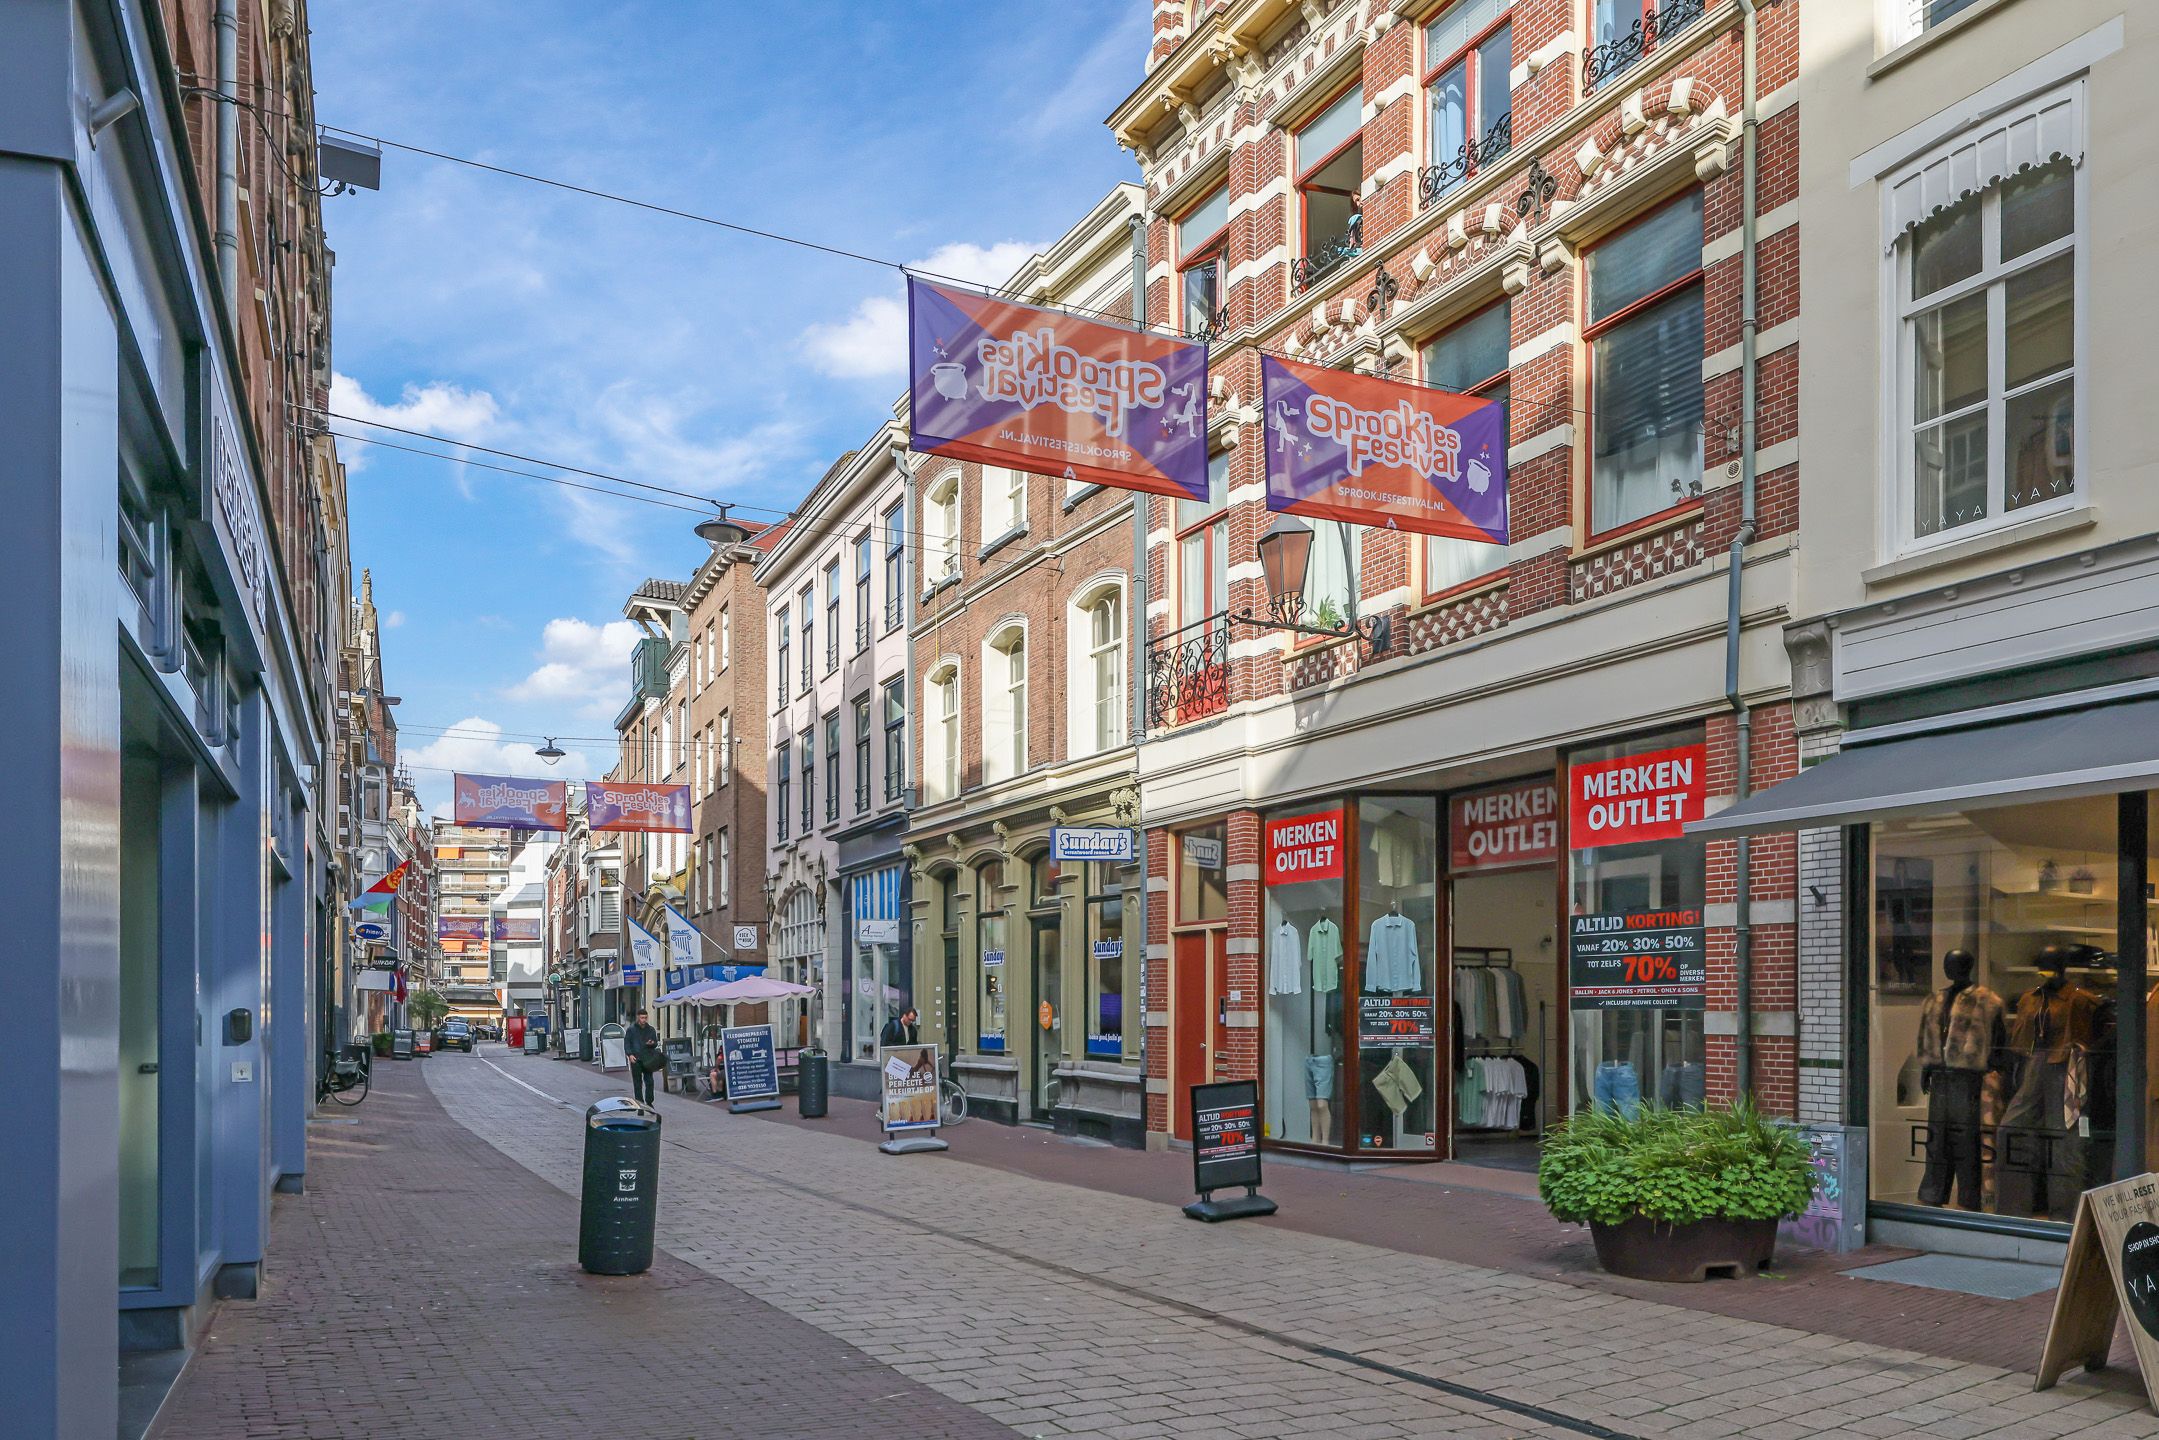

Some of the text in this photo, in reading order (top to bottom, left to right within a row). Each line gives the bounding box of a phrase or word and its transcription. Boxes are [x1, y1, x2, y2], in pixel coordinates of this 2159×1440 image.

[1309, 400, 1459, 453] Sprookjes
[1351, 433, 1457, 478] Festival
[1338, 486, 1446, 512] SPROOKJESFESTIVAL.NL
[1583, 758, 1693, 800] MERKEN
[604, 789, 669, 805] Sprookjes
[1464, 786, 1557, 826] MERKEN
[623, 801, 669, 815] Festival
[1588, 793, 1688, 831] OUTLET
[1273, 819, 1337, 849] MERKEN
[1468, 820, 1557, 857] OUTLET
[1060, 832, 1128, 855] Sunday's
[1275, 845, 1335, 873] OUTLET
[1576, 909, 1700, 933] ALTIJD KORTING!
[1577, 935, 1694, 953] VANAF 20% 30% 50%
[1587, 954, 1677, 983] TOT ZELFS 70%
[1363, 998, 1390, 1007] ALTIJD
[1378, 1010, 1393, 1018] 20%
[1395, 1010, 1410, 1018] 30%
[1390, 1019, 1418, 1034] 70%
[888, 1079, 923, 1088] PERFECTE
[911, 1071, 921, 1079] JE
[924, 1085, 934, 1093] OP
[1198, 1112, 1220, 1122] ALTIJD
[1238, 1120, 1250, 1128] 50%
[1220, 1131, 1245, 1145] 70%
[2103, 1183, 2156, 1208] WE WILL RESET
[2108, 1208, 2128, 1222] YOUR
[2127, 1240, 2143, 1253] SHOP
[2142, 1238, 2150, 1249] IN
